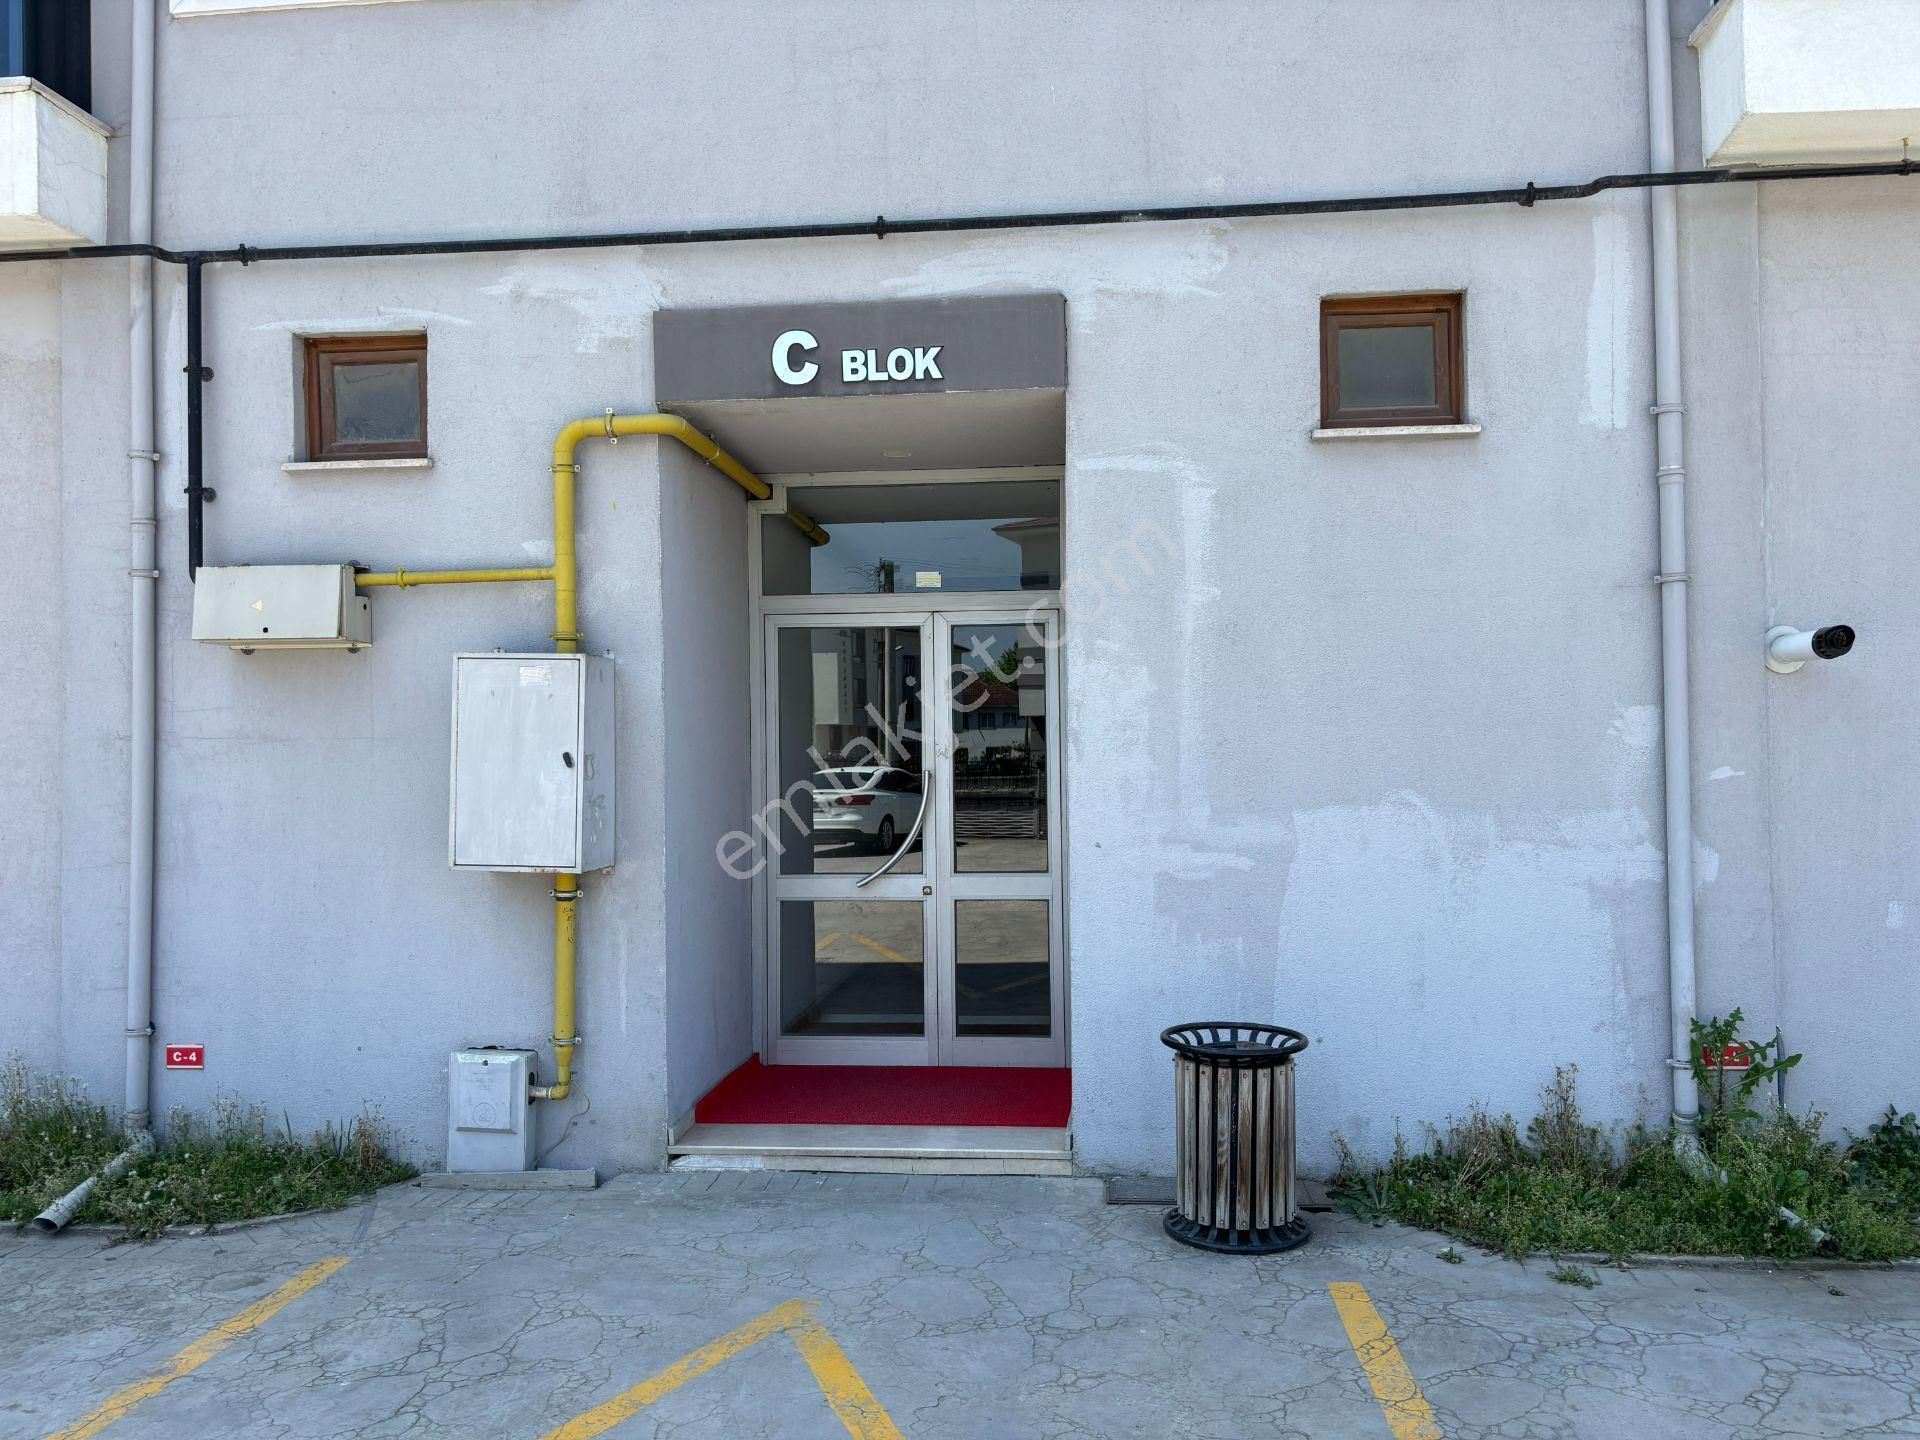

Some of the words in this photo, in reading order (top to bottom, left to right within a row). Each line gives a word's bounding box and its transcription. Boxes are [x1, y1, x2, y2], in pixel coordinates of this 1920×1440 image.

[771, 329, 820, 386] C
[841, 345, 944, 383] BLOK
[173, 1051, 197, 1062] C-4
